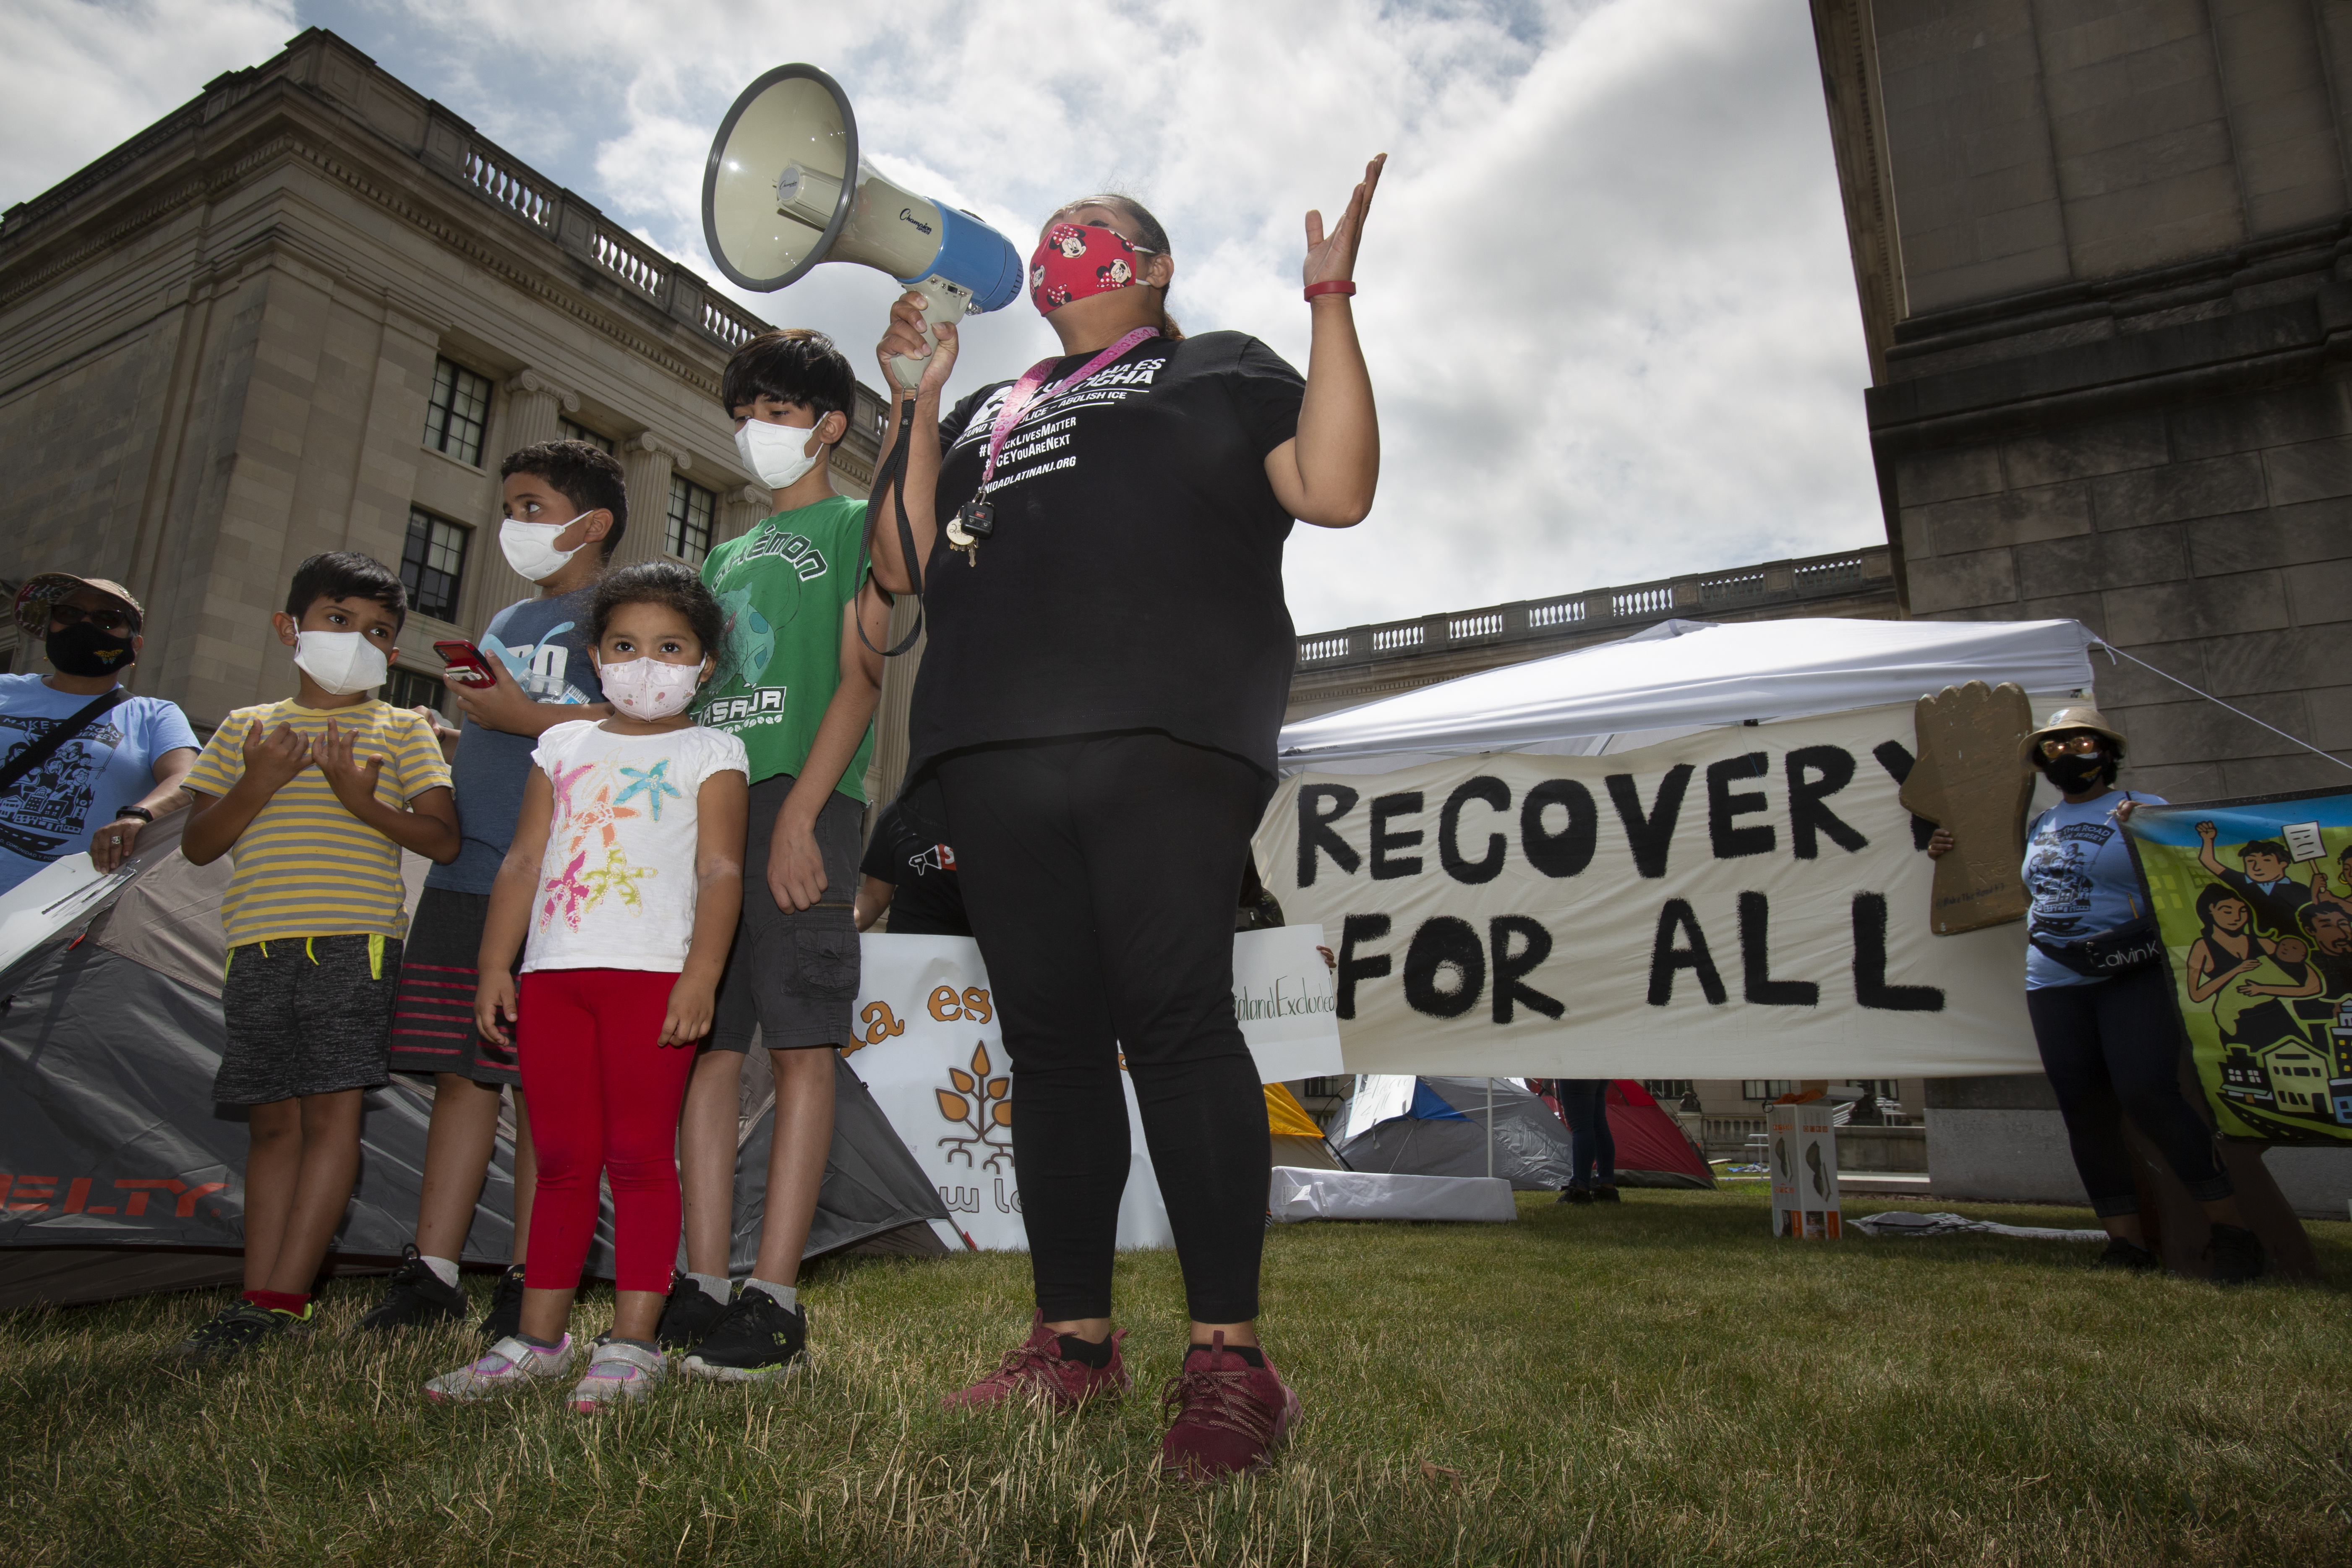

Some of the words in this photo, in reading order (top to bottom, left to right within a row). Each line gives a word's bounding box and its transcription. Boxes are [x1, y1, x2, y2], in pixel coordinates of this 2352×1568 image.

[900, 208, 932, 232] Champion
[1134, 358, 1166, 370] ES
[1019, 407, 1049, 424] LICE
[1058, 391, 1107, 408] ABOLISH
[978, 456, 1076, 494] NIDADLATINANJ.ORG
[3, 718, 50, 729] MAKE
[85, 725, 120, 738] ROAD
[76, 731, 116, 742] JERSEY
[2064, 826, 2081, 835] THE
[2082, 824, 2110, 836] ROAD
[2075, 832, 2105, 842] JERSEY
[6, 841, 37, 858] COMUNIDAD
[1336, 912, 1567, 1025] FOR
[1646, 890, 1945, 1012] ALL
[256, 1312, 275, 1323] WORLD
